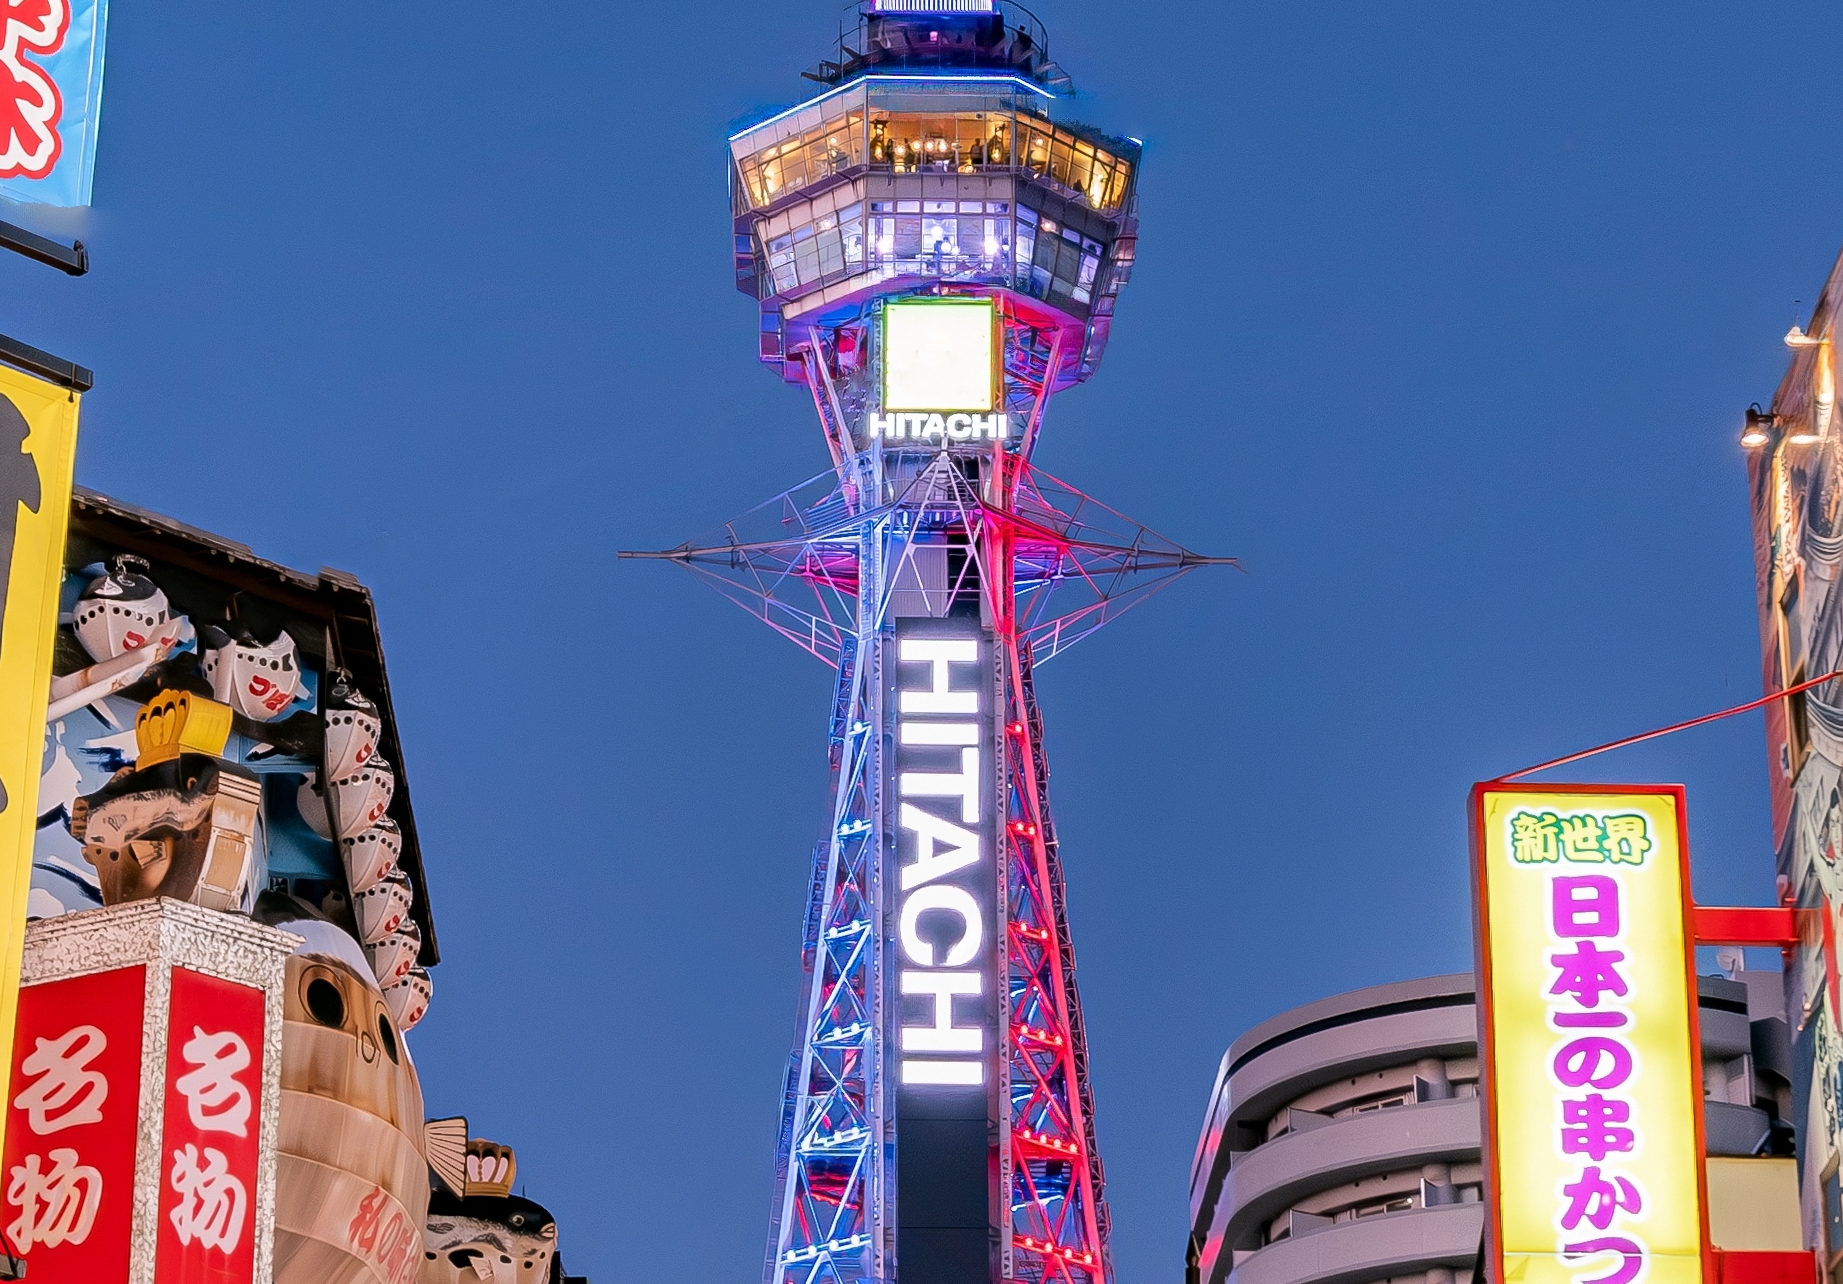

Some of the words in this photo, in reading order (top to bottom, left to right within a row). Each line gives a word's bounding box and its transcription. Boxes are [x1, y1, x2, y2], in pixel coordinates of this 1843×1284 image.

[868, 412, 1008, 442] HITACHI
[898, 639, 985, 1085] HITACHI
[1510, 809, 1652, 867] 新世界
